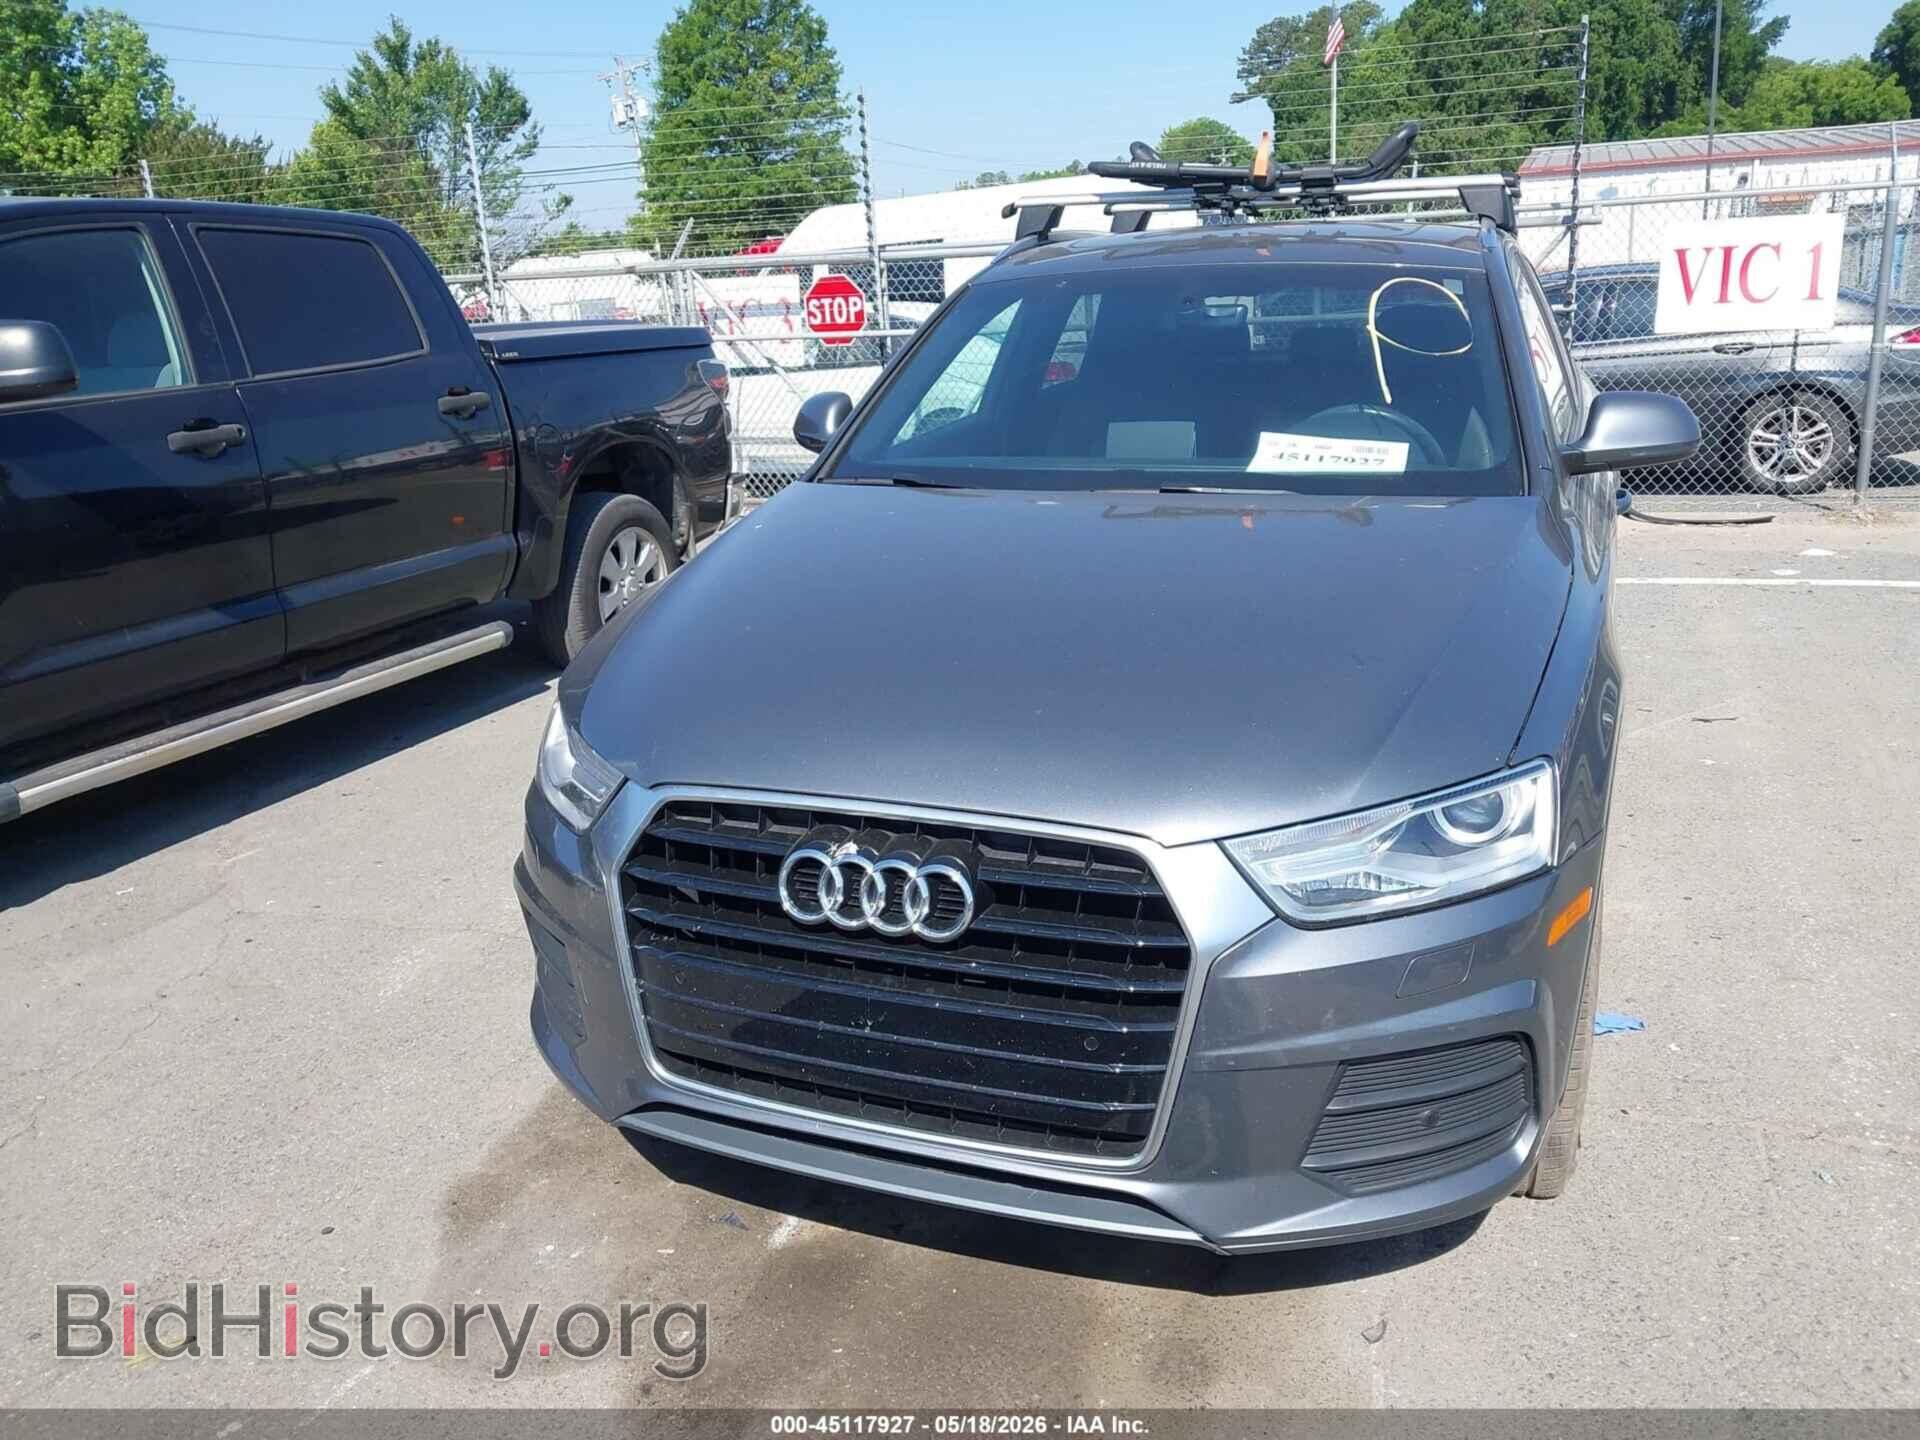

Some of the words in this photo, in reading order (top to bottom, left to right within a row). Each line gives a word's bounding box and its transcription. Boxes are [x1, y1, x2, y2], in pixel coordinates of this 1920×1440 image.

[1673, 242, 1783, 306] VIC
[1802, 241, 1825, 301] 1
[808, 296, 863, 325] STOP
